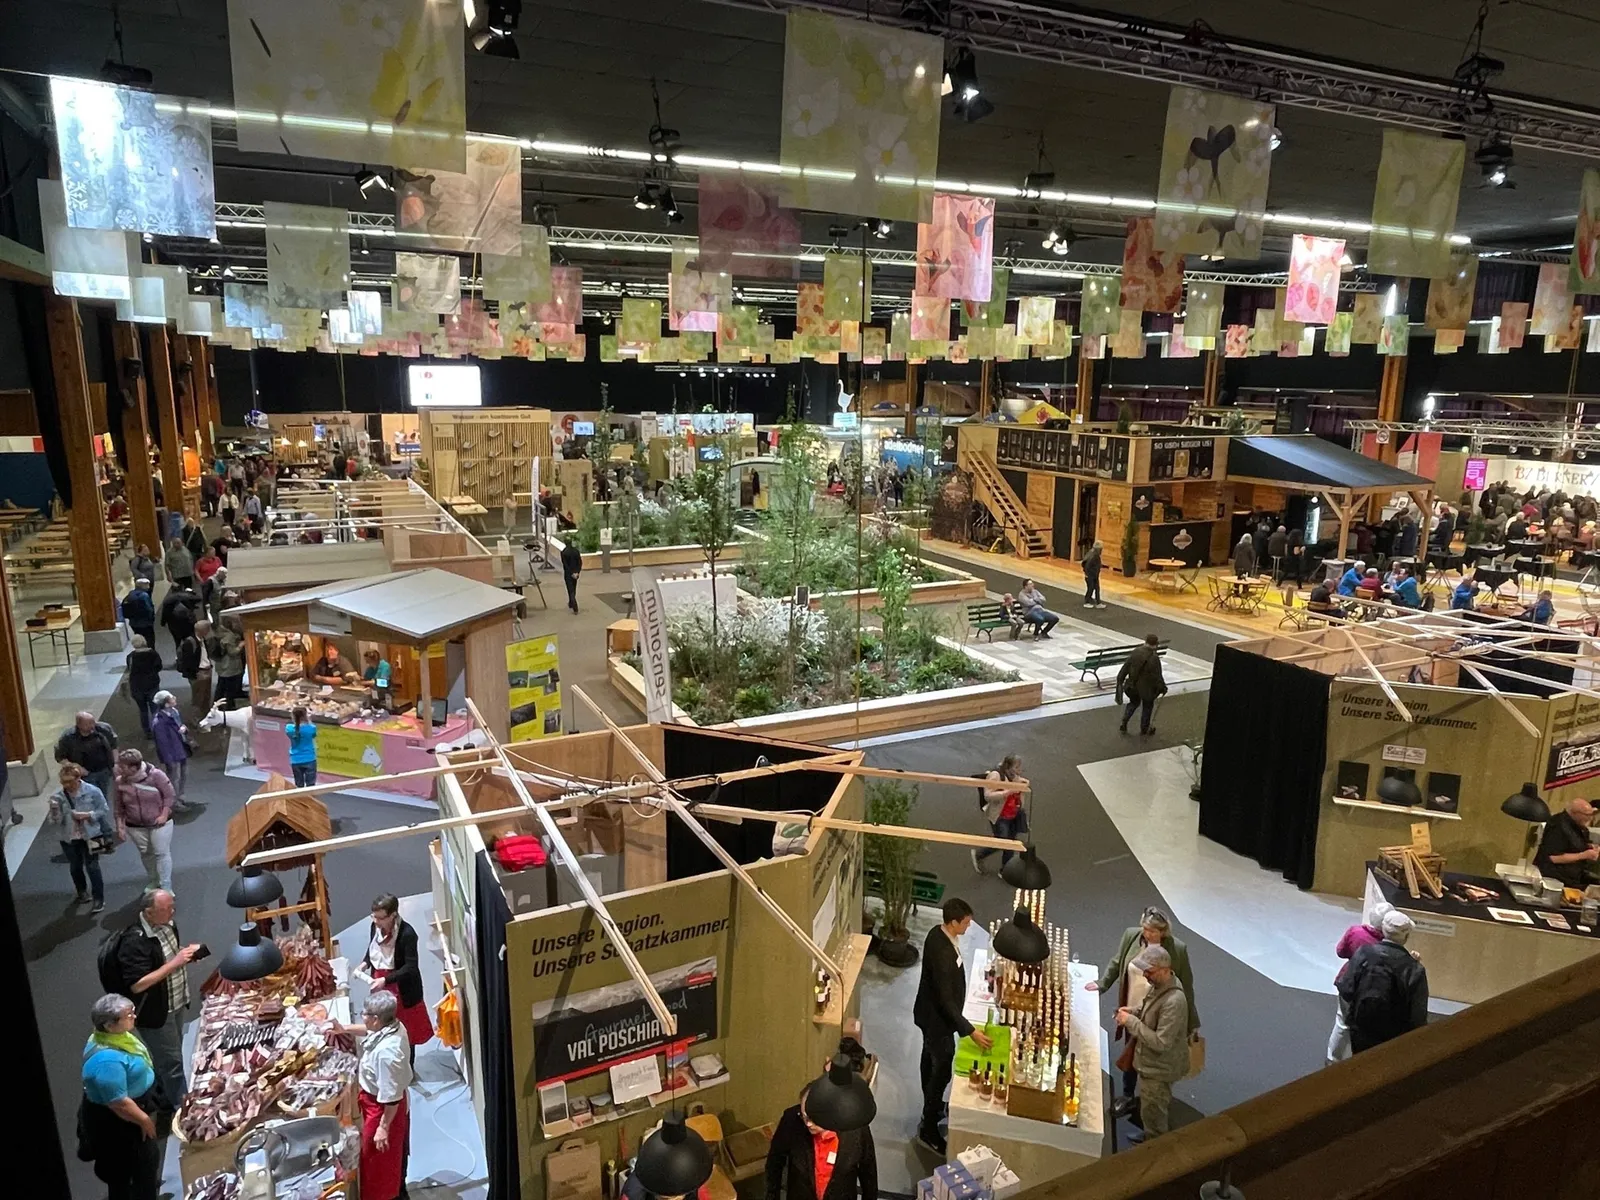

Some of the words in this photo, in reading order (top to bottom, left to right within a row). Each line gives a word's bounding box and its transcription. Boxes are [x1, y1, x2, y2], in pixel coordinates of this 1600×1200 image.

[1154, 442, 1163, 450] SO
[1343, 693, 1384, 708] Unsere
[1386, 699, 1430, 712] Rgion.
[1341, 706, 1382, 721] Unsere
[1384, 711, 1478, 731] Sctzkammer.
[531, 929, 595, 956] Unsere
[532, 950, 597, 978] Unsere
[567, 1039, 596, 1062] VAL
[598, 1013, 678, 1054] POSCHIAO
[585, 1006, 650, 1044] Gourmet
